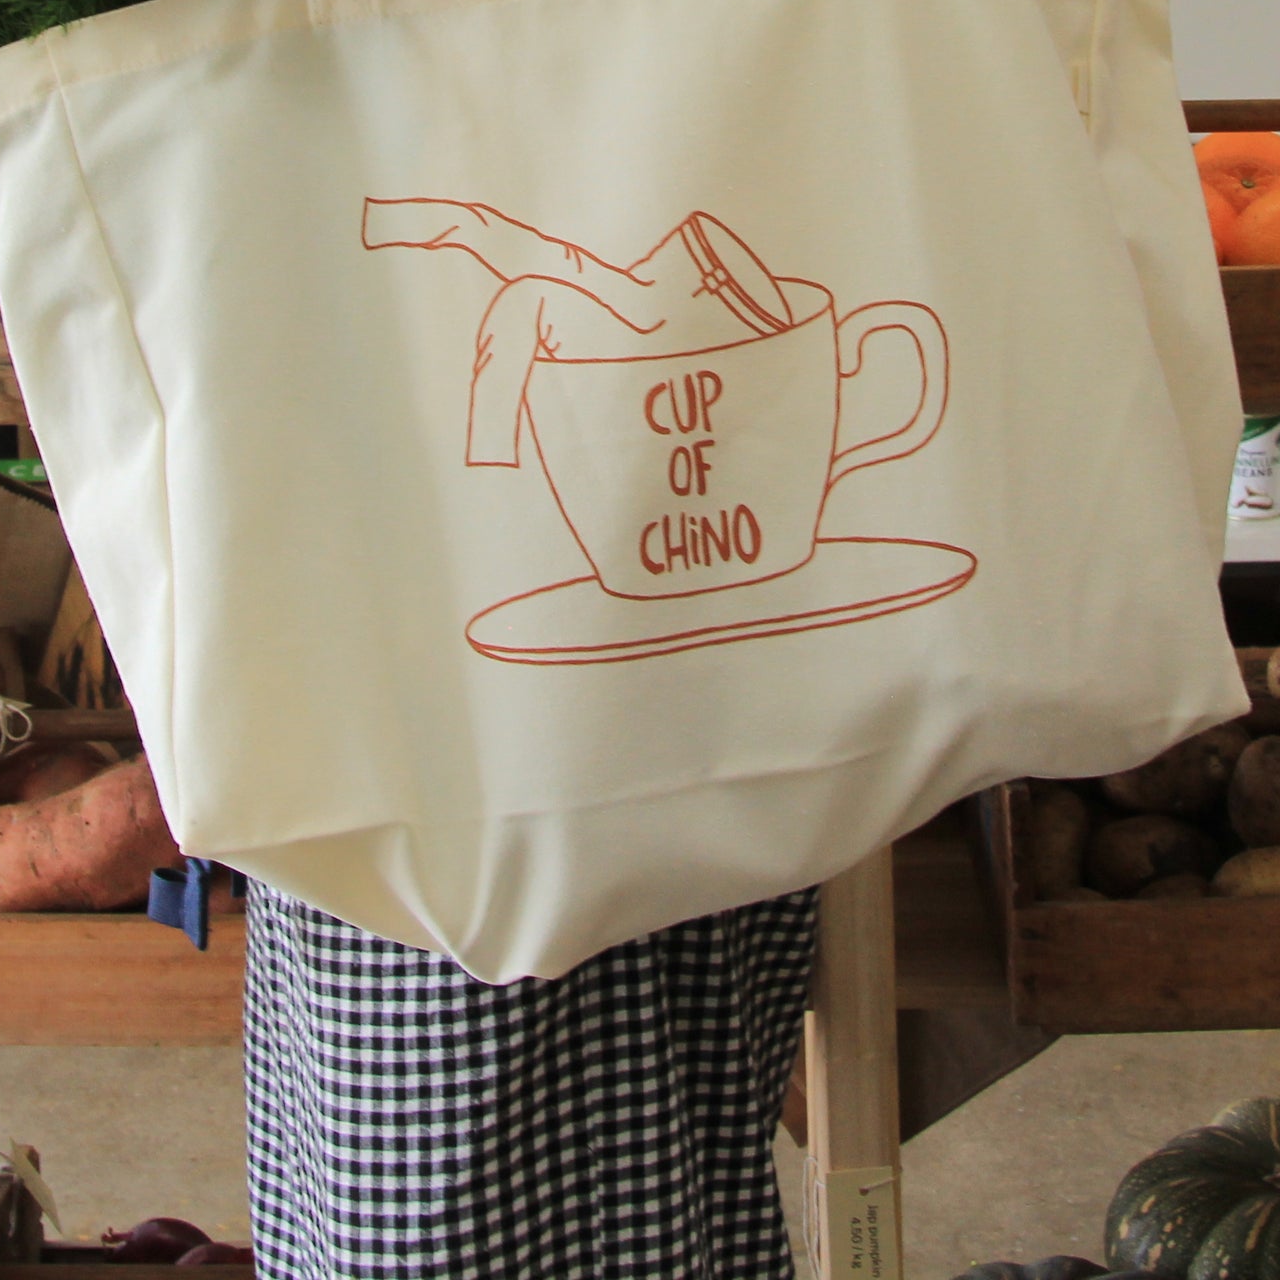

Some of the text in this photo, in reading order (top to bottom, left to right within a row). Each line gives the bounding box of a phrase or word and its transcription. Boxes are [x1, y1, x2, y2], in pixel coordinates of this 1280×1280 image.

[643, 370, 723, 435] CUP
[668, 439, 715, 496] OF
[867, 1226, 882, 1279] pumpkin
